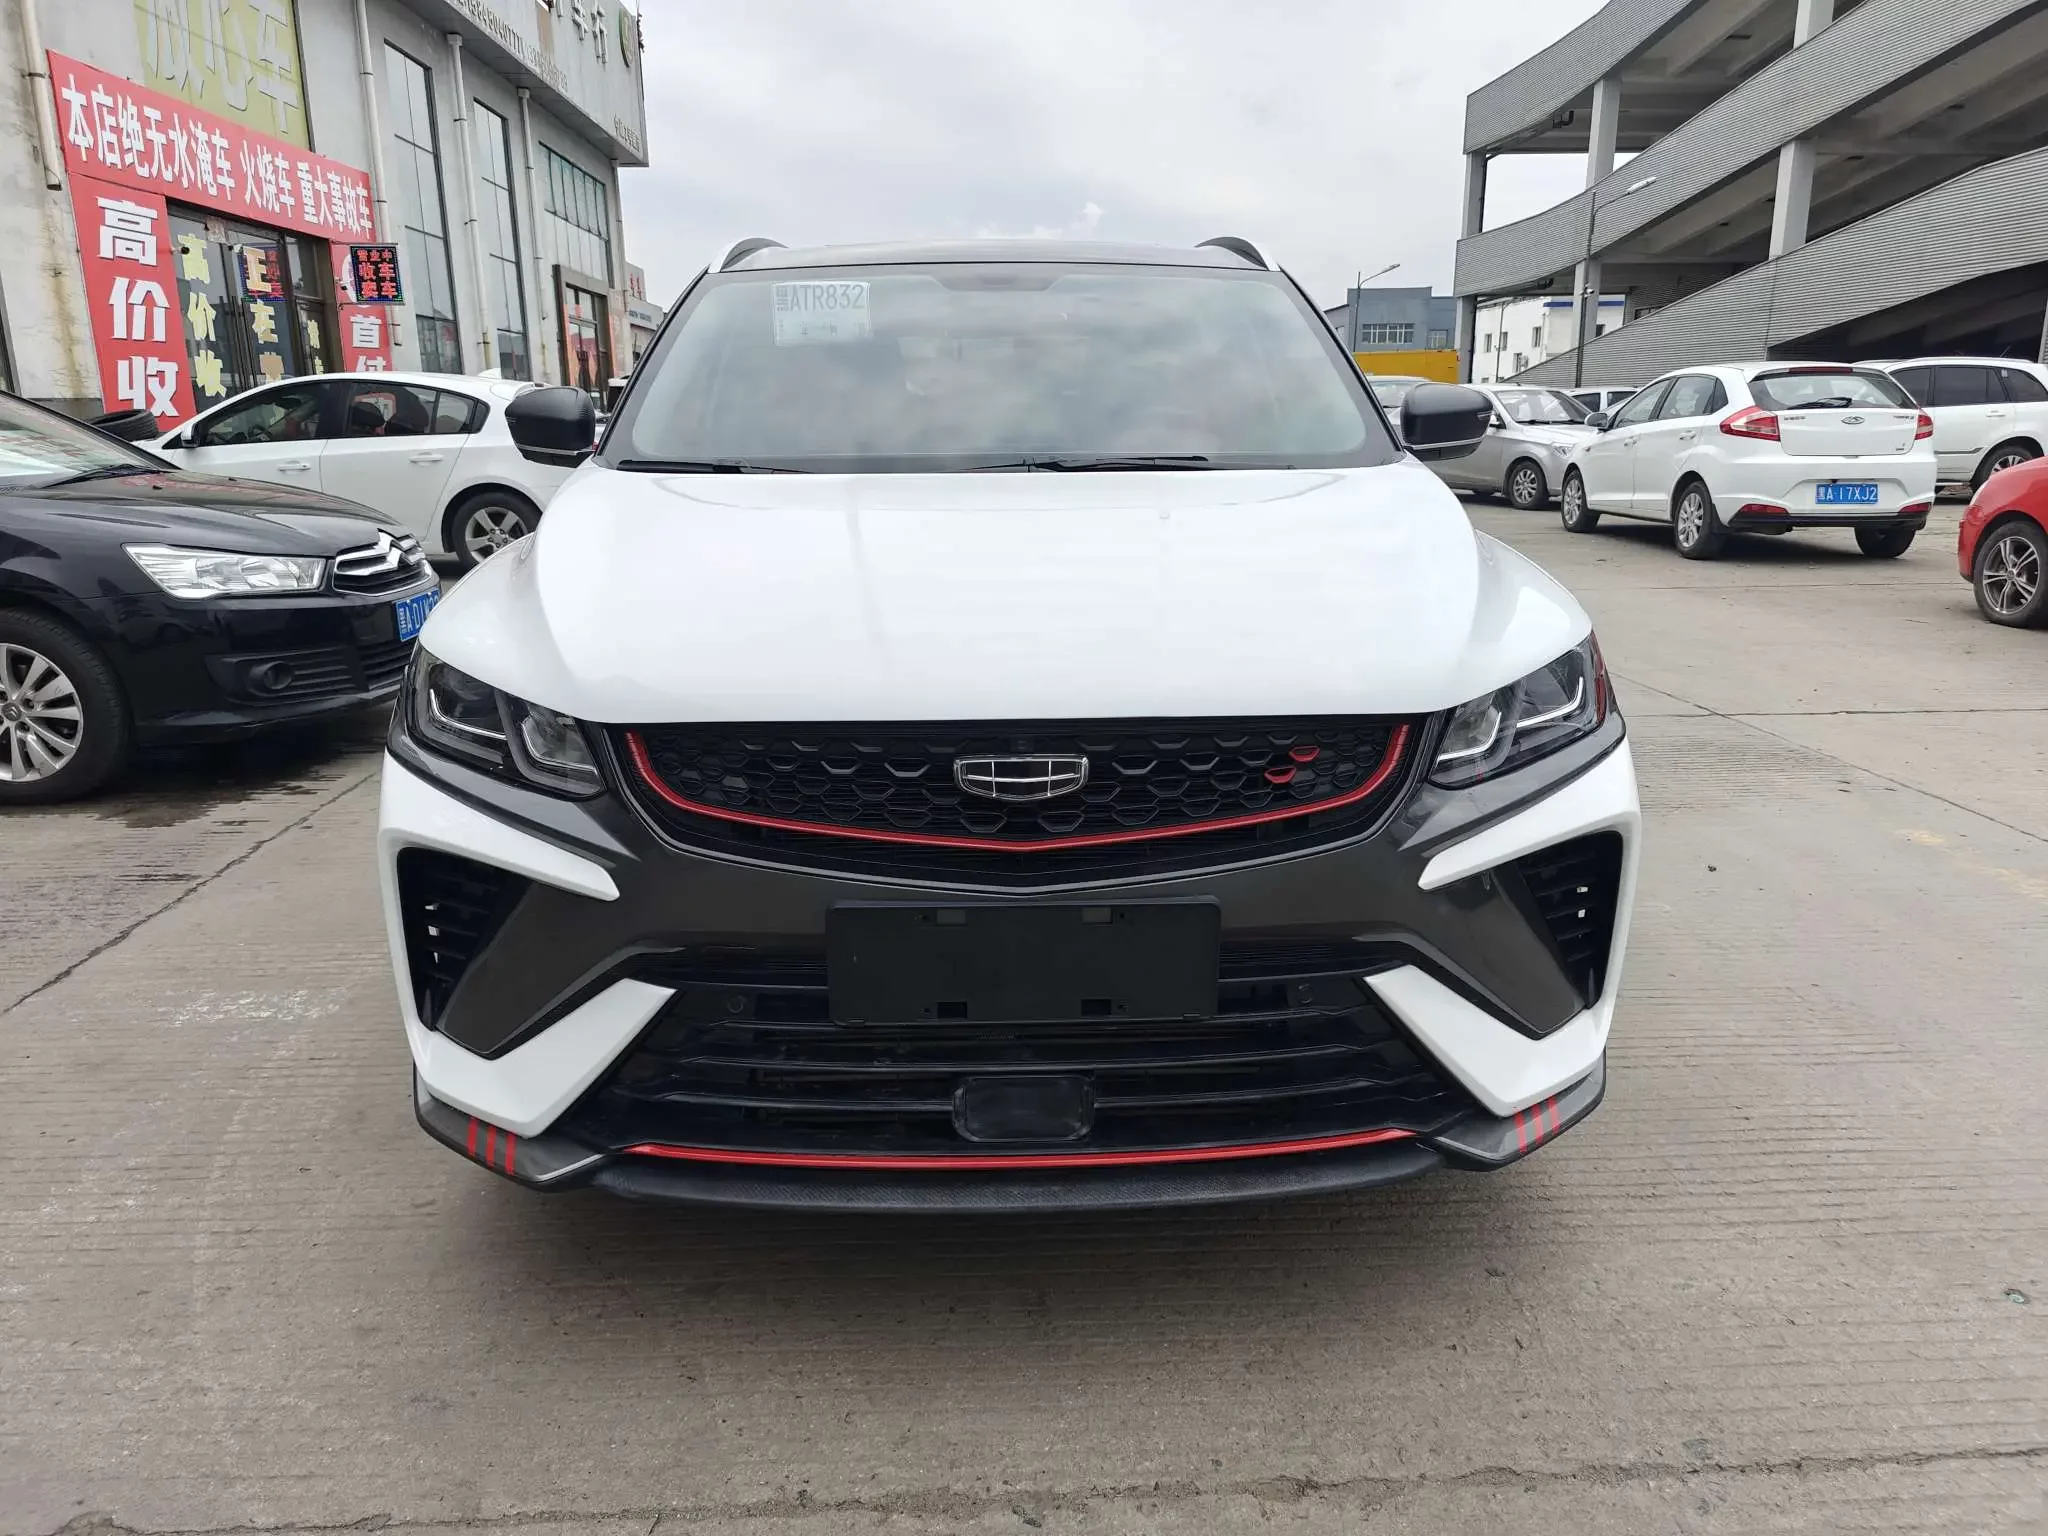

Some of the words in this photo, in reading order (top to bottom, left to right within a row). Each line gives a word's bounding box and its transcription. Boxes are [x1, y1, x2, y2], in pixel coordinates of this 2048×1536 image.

[61, 73, 236, 201] 本店绝无水淹车
[239, 139, 295, 218] 火烧车
[297, 161, 373, 240] 重大事故车
